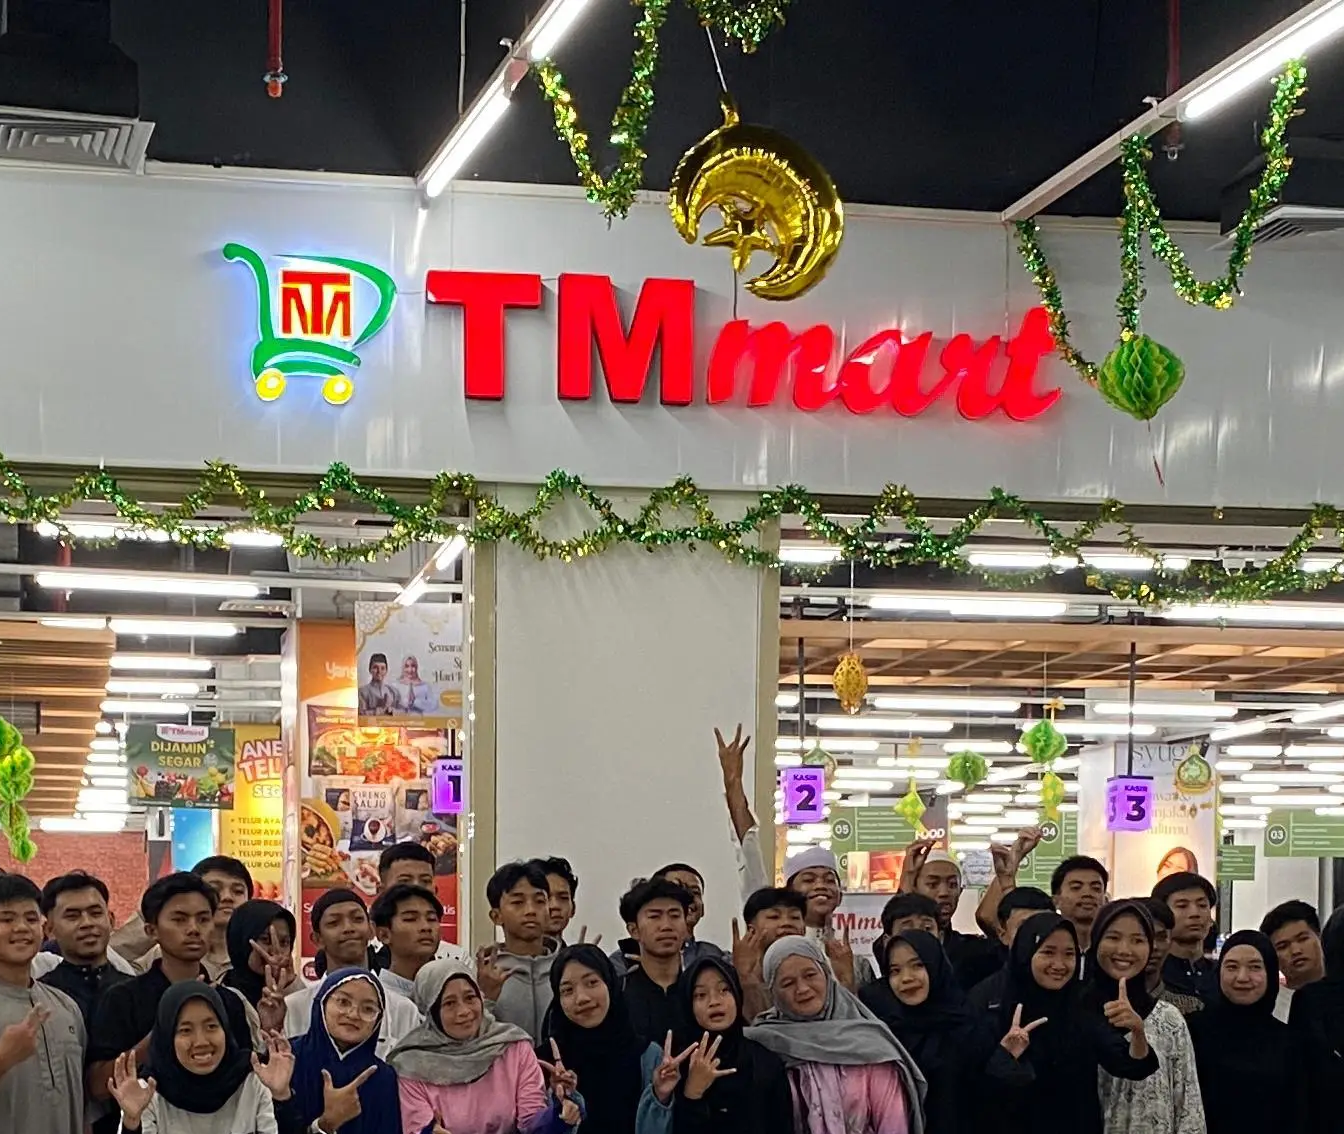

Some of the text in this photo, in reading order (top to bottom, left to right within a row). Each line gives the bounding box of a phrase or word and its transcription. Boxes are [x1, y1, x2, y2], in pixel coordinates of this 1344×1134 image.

[425, 269, 1063, 421] TMmart
[151, 741, 206, 754] DIJAMIN
[158, 756, 201, 767] SEGAR
[795, 785, 817, 811] 2
[1126, 796, 1146, 821] 3
